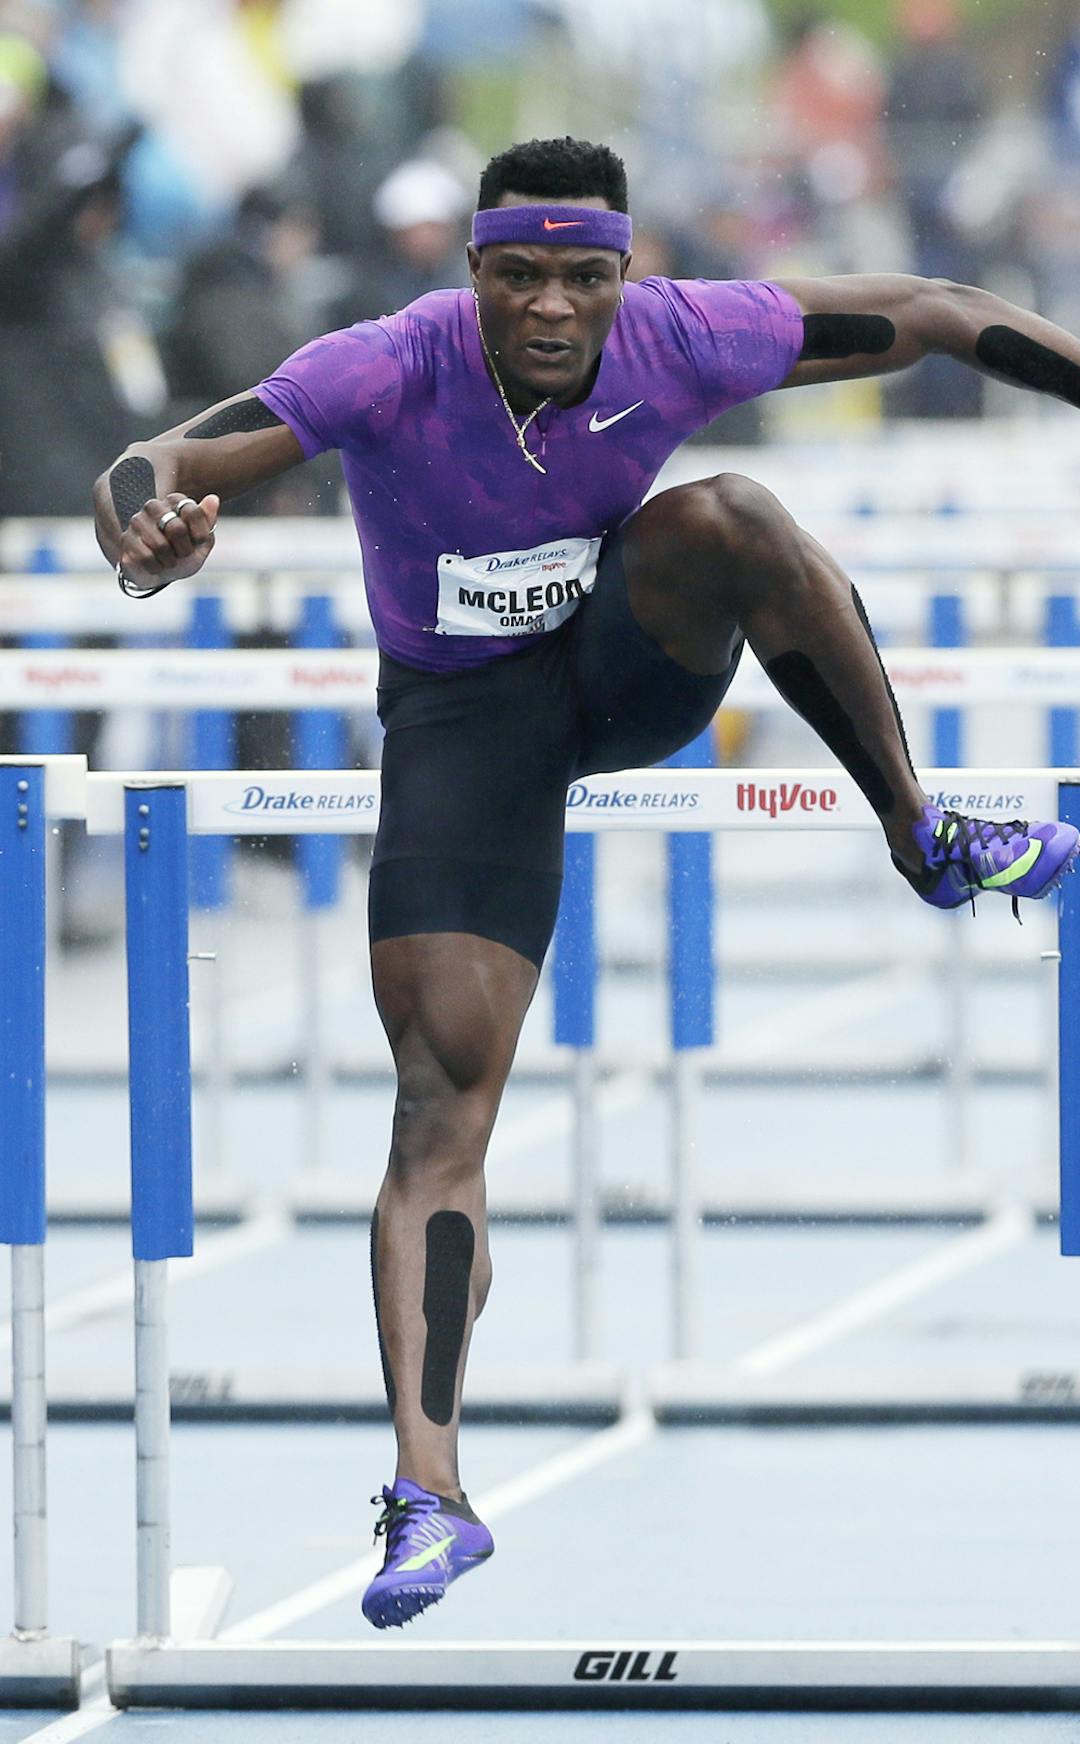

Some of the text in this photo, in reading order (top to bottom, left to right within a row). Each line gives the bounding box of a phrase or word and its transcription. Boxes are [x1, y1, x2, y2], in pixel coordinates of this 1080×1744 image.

[486, 549, 568, 572] Drake RELAYS
[241, 786, 375, 810] Drake RELAYS
[566, 783, 1024, 818] Drake RELAYS HyVee ake RELAYS
[574, 1651, 678, 1680] GILL
